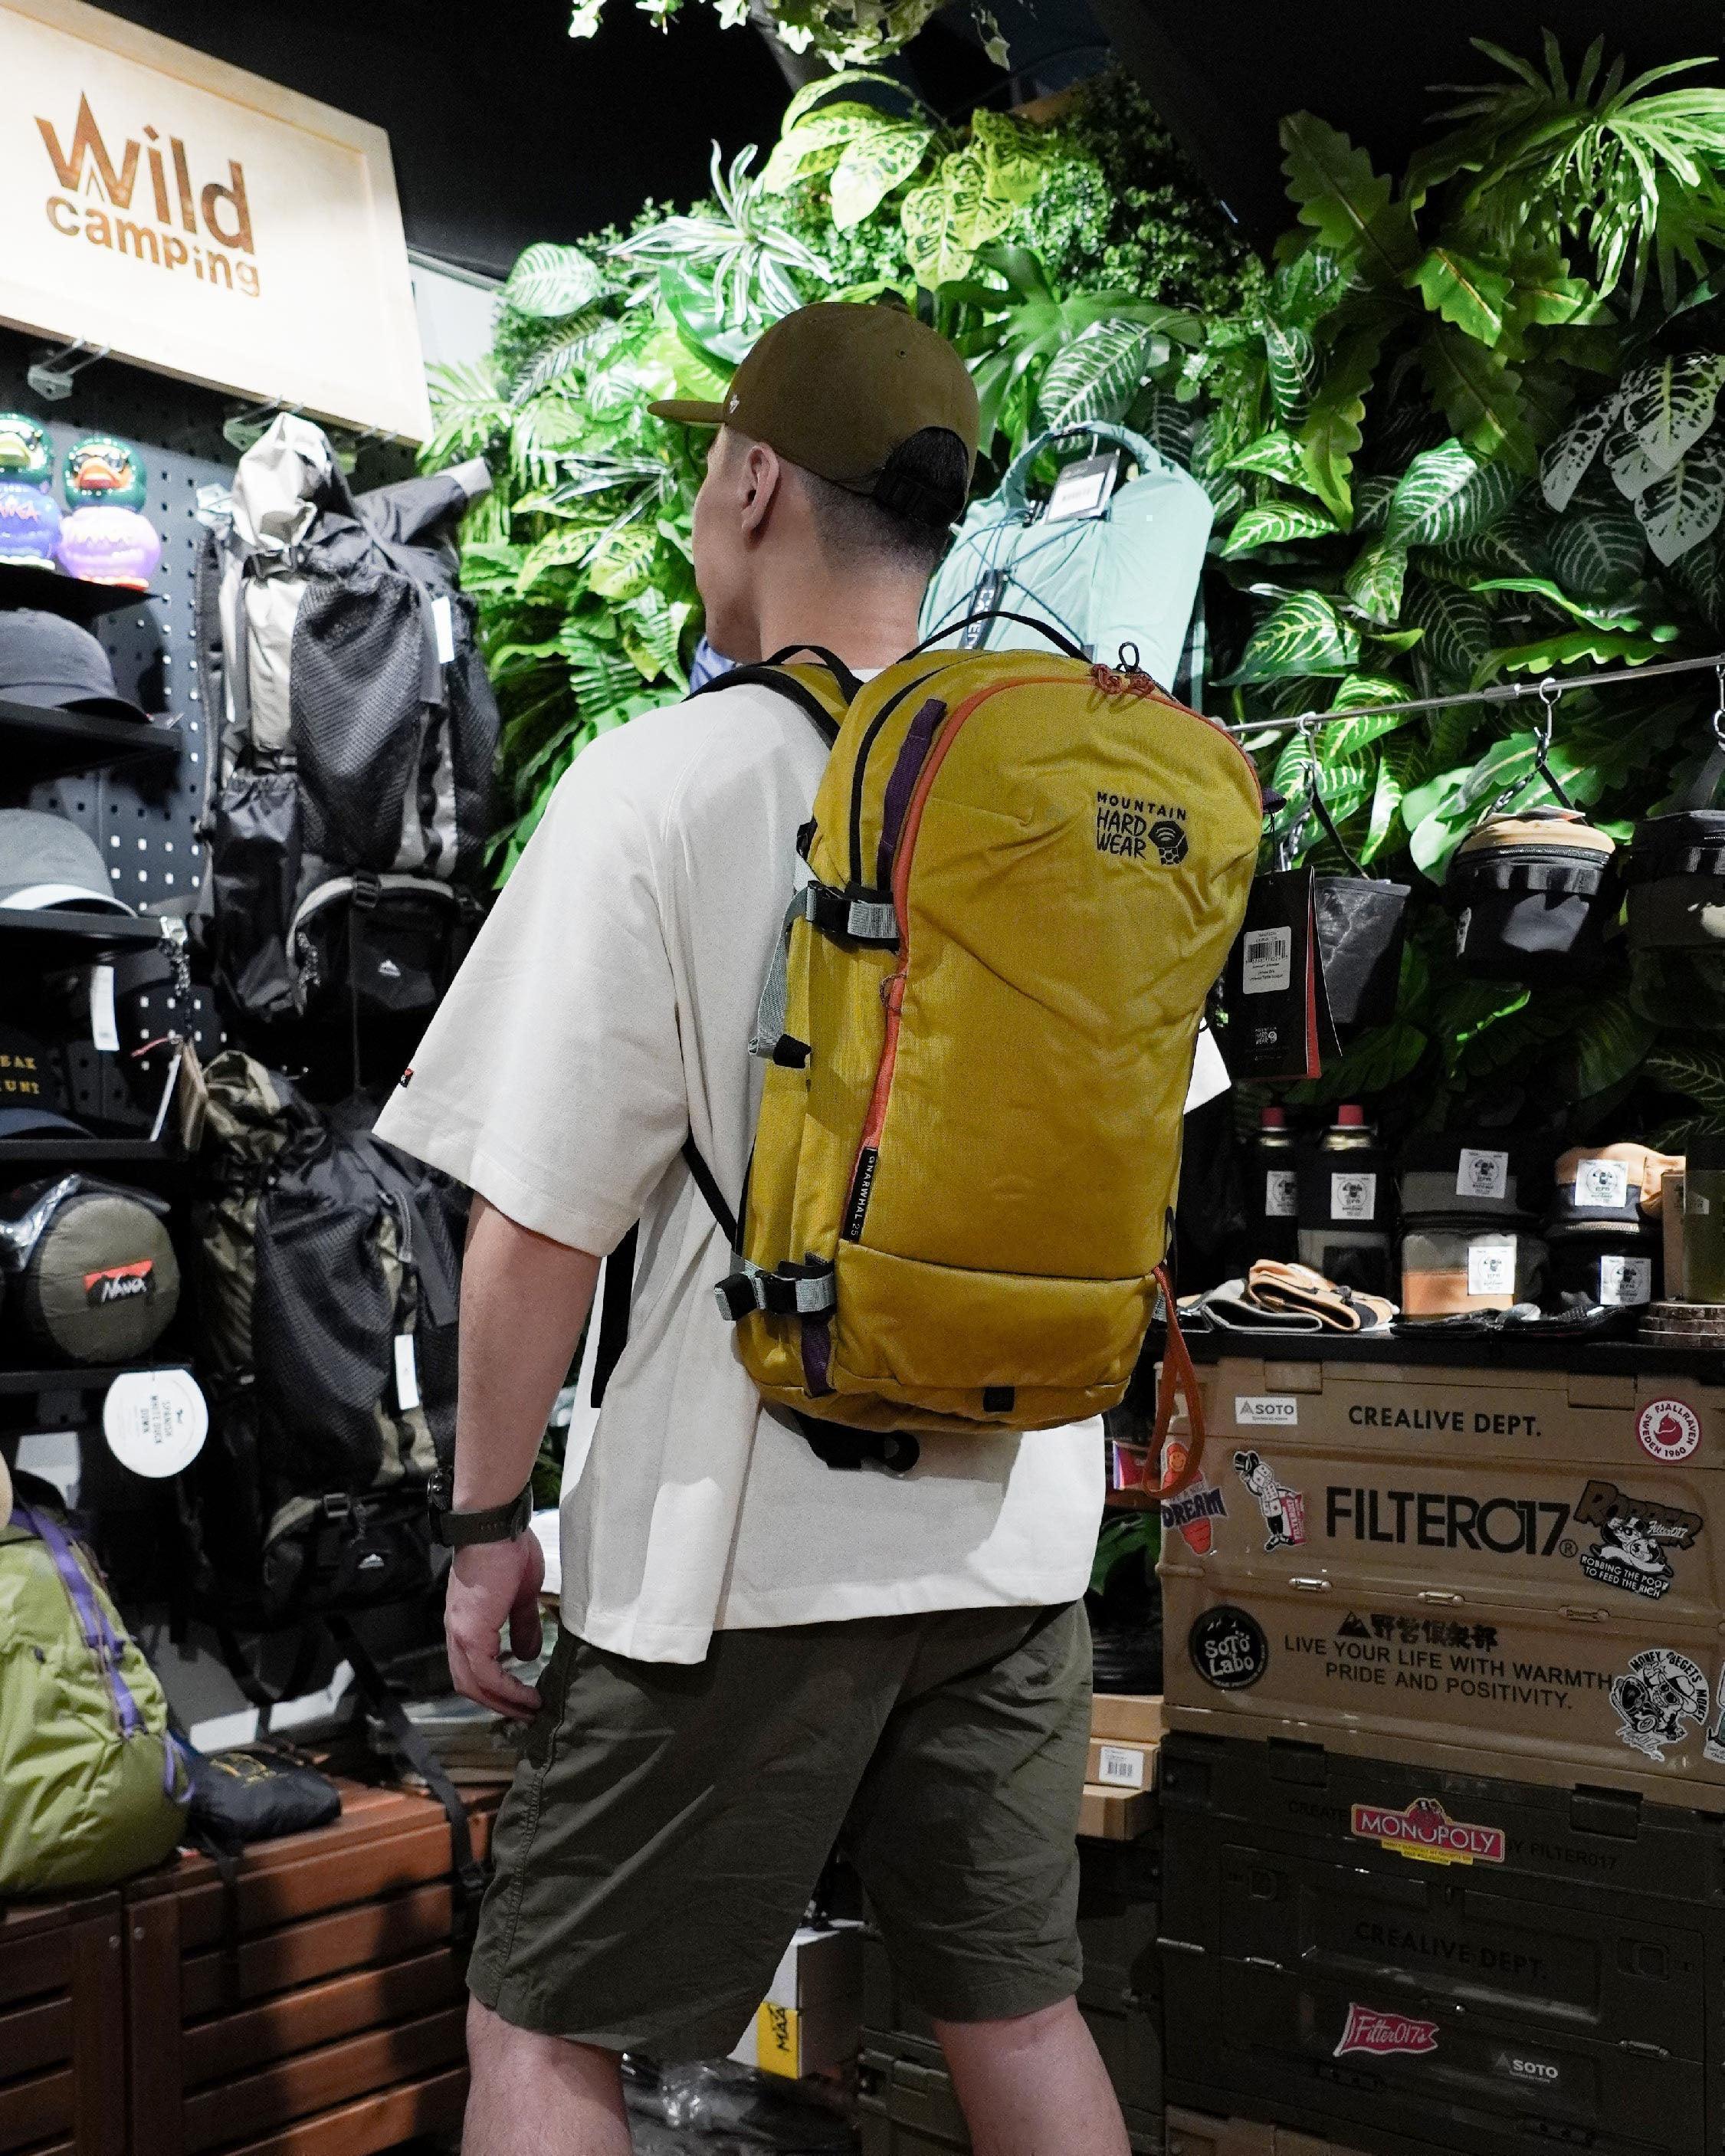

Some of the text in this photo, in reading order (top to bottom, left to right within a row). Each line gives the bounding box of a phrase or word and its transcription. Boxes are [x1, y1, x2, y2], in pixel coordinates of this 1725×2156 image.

[35, 90, 255, 254] Wild
[46, 196, 261, 297] camping
[1097, 791, 1186, 821] MOUNTAIN
[1097, 807, 1147, 837] HARD
[1096, 829, 1147, 861] WEAR
[851, 1156, 875, 1236] GNARWHAL 25
[1255, 1404, 1294, 1415] SOTO
[1349, 1405, 1541, 1437] CREALIVE DEPT.
[1641, 1414, 1687, 1457] SWEDEN 1960
[1161, 1488, 1228, 1528] DREAM
[1582, 1555, 1669, 1591] ROBBING THE POOR
[1586, 1567, 1661, 1598] TO FEED THE RICH
[1284, 1634, 1612, 1690] LIVE YOUR LIFE WITH WARMTH
[1326, 1662, 1572, 1710] PRIDE AND POSITIVITY.
[1630, 1651, 1661, 1672] MONEY
[1692, 1688, 1707, 1724] MONEY
[1361, 1812, 1495, 1854] MONOPOLY
[1354, 1921, 1547, 1981] CREALIVE DEPT.
[1513, 2059, 1559, 2079] SOTO
